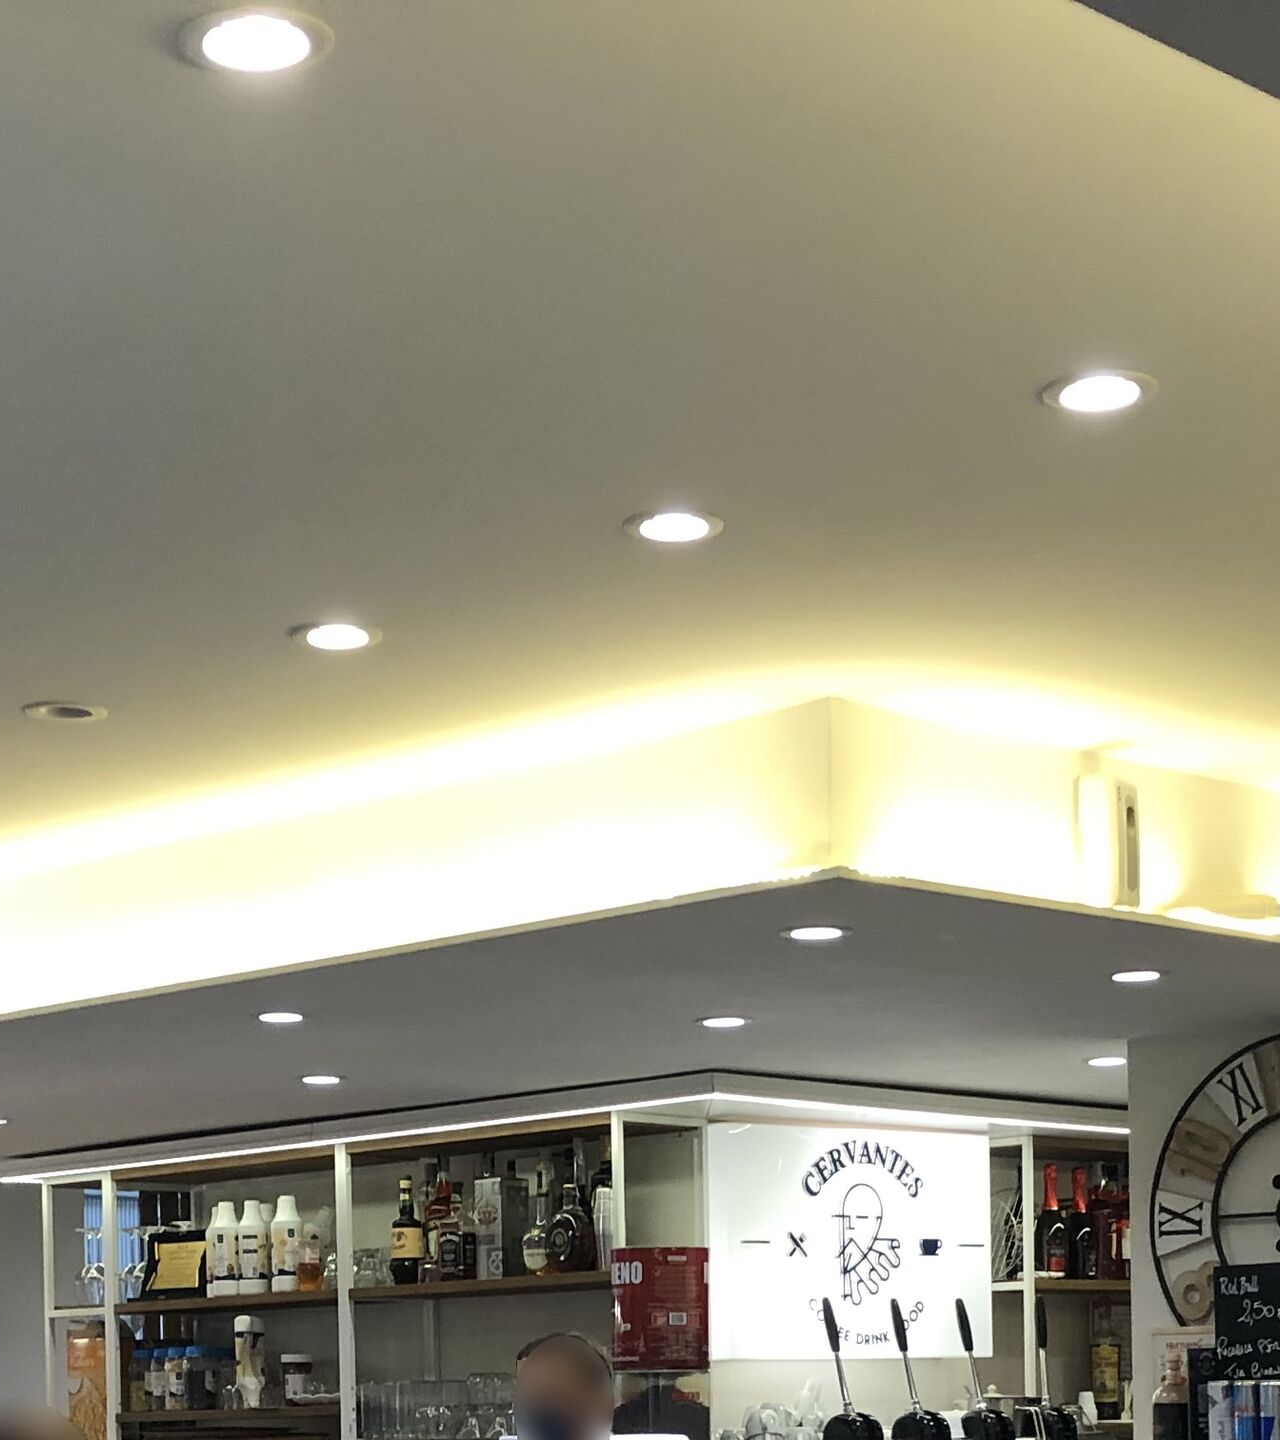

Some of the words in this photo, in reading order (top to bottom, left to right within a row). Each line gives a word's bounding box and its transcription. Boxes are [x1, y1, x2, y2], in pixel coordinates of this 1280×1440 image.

[801, 1139, 924, 1198] CERVANTES
[809, 1298, 850, 1342] COEE
[856, 1331, 890, 1345] DRINK
[894, 1300, 924, 1333] OOD
